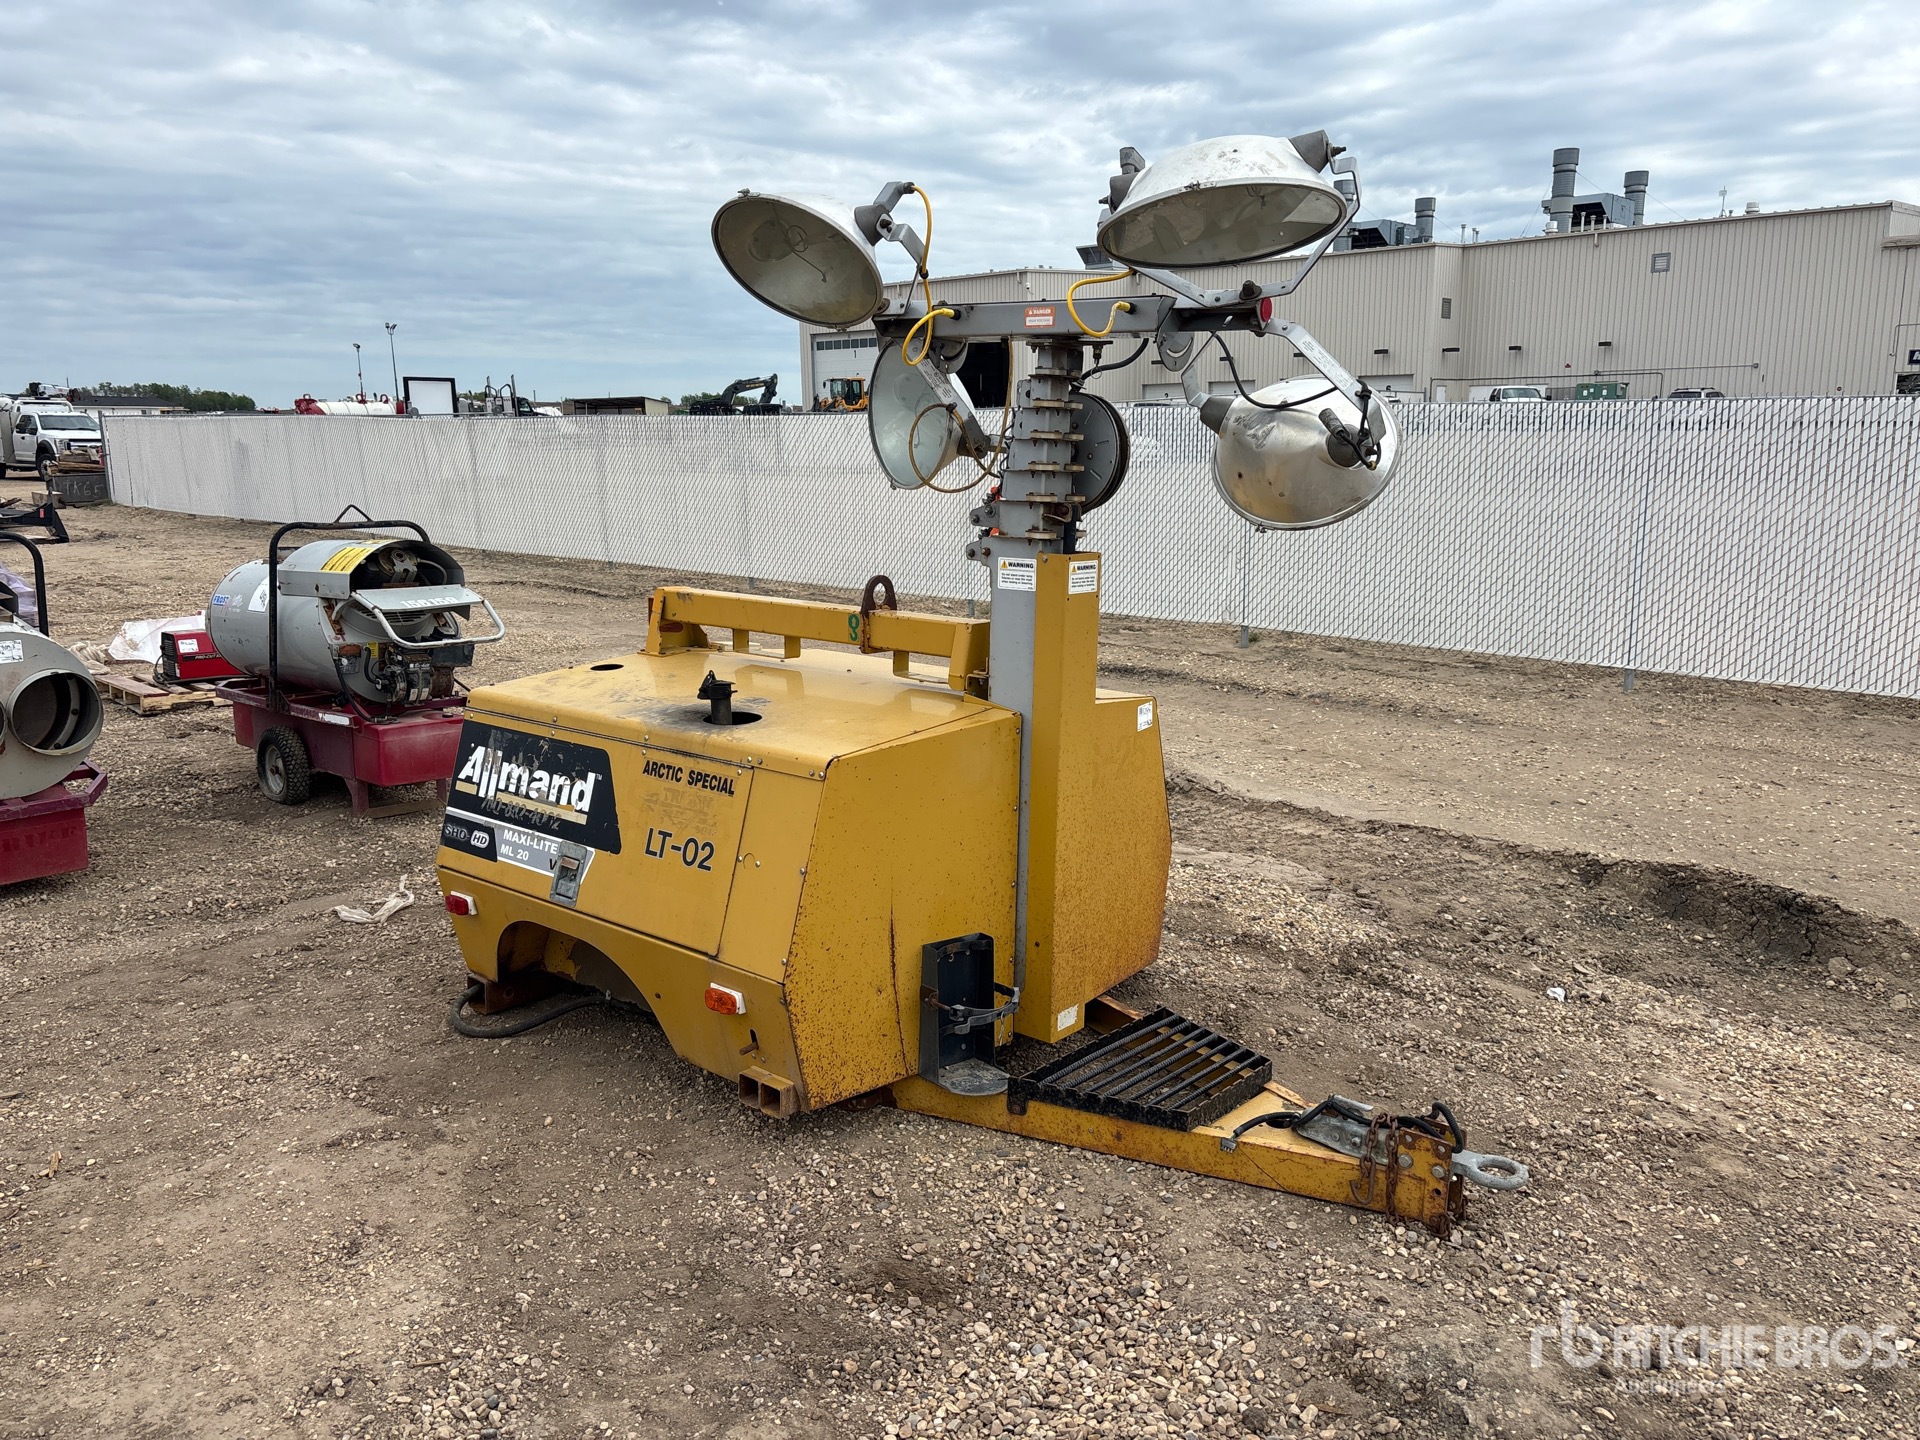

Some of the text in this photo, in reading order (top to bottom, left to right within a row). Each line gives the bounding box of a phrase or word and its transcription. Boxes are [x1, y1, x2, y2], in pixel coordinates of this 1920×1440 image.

[1008, 561, 1034, 569] WARNING
[457, 745, 596, 812] Allmand
[642, 760, 735, 796] ARCTIC SPECIAL
[500, 843, 529, 861] ML 20
[503, 829, 559, 855] MAXI-LITE
[645, 828, 715, 872] LT-02
